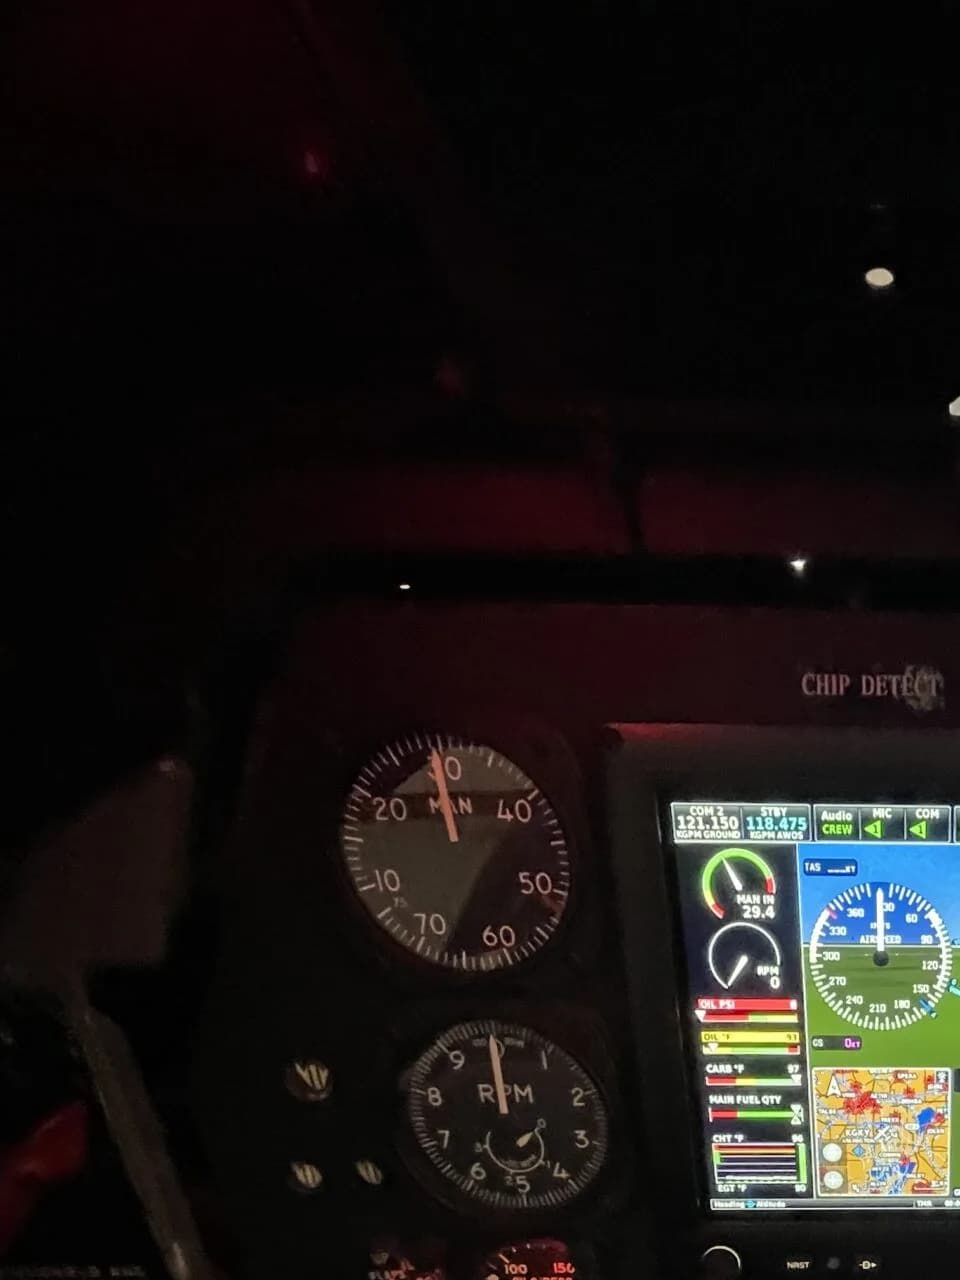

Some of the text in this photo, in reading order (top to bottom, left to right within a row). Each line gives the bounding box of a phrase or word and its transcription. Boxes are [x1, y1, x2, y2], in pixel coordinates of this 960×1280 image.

[801, 673, 940, 698] CHIP DETECT
[373, 797, 407, 821] 20
[496, 799, 532, 823] 40
[689, 805, 724, 816] COM 2
[760, 806, 787, 817] STBY
[872, 807, 892, 818] MIC
[915, 808, 940, 819] COM
[821, 810, 853, 821] Audio
[677, 815, 739, 830] 121.150
[746, 816, 807, 831] 118.475
[703, 830, 740, 839] GROUND
[822, 823, 852, 835] CREW
[776, 831, 803, 840] AWOS
[804, 863, 821, 872] TAS
[375, 869, 400, 892] 10
[518, 872, 552, 895] 50
[736, 894, 775, 905] MAN IN
[742, 905, 775, 919] 29.4
[846, 908, 865, 918] 360
[905, 913, 918, 923] 60
[413, 913, 446, 935] 70
[482, 925, 516, 947] 60
[829, 926, 847, 936] 330
[921, 935, 933, 944] 90
[822, 951, 840, 961] 300
[757, 965, 779, 976] RPM
[922, 960, 938, 970] 120
[769, 976, 780, 989] 0
[828, 976, 846, 986] 270
[912, 984, 929, 994] 150
[845, 995, 864, 1005] 240
[893, 1000, 911, 1010] 180
[869, 1003, 887, 1014] 210
[812, 1038, 824, 1048] GS
[450, 1051, 465, 1070] 9
[541, 1050, 548, 1070] 1
[705, 1064, 732, 1074] CARB
[427, 1088, 442, 1106] 8
[572, 1088, 585, 1106] 2
[709, 1095, 782, 1105] MAIN FUEL QTY
[439, 1130, 449, 1148] 7
[574, 1130, 589, 1148] 3
[712, 1134, 732, 1143] CHT
[470, 1162, 486, 1180] 6
[552, 1163, 570, 1179] 4
[516, 1176, 530, 1193] 5
[504, 1264, 528, 1275] 100
